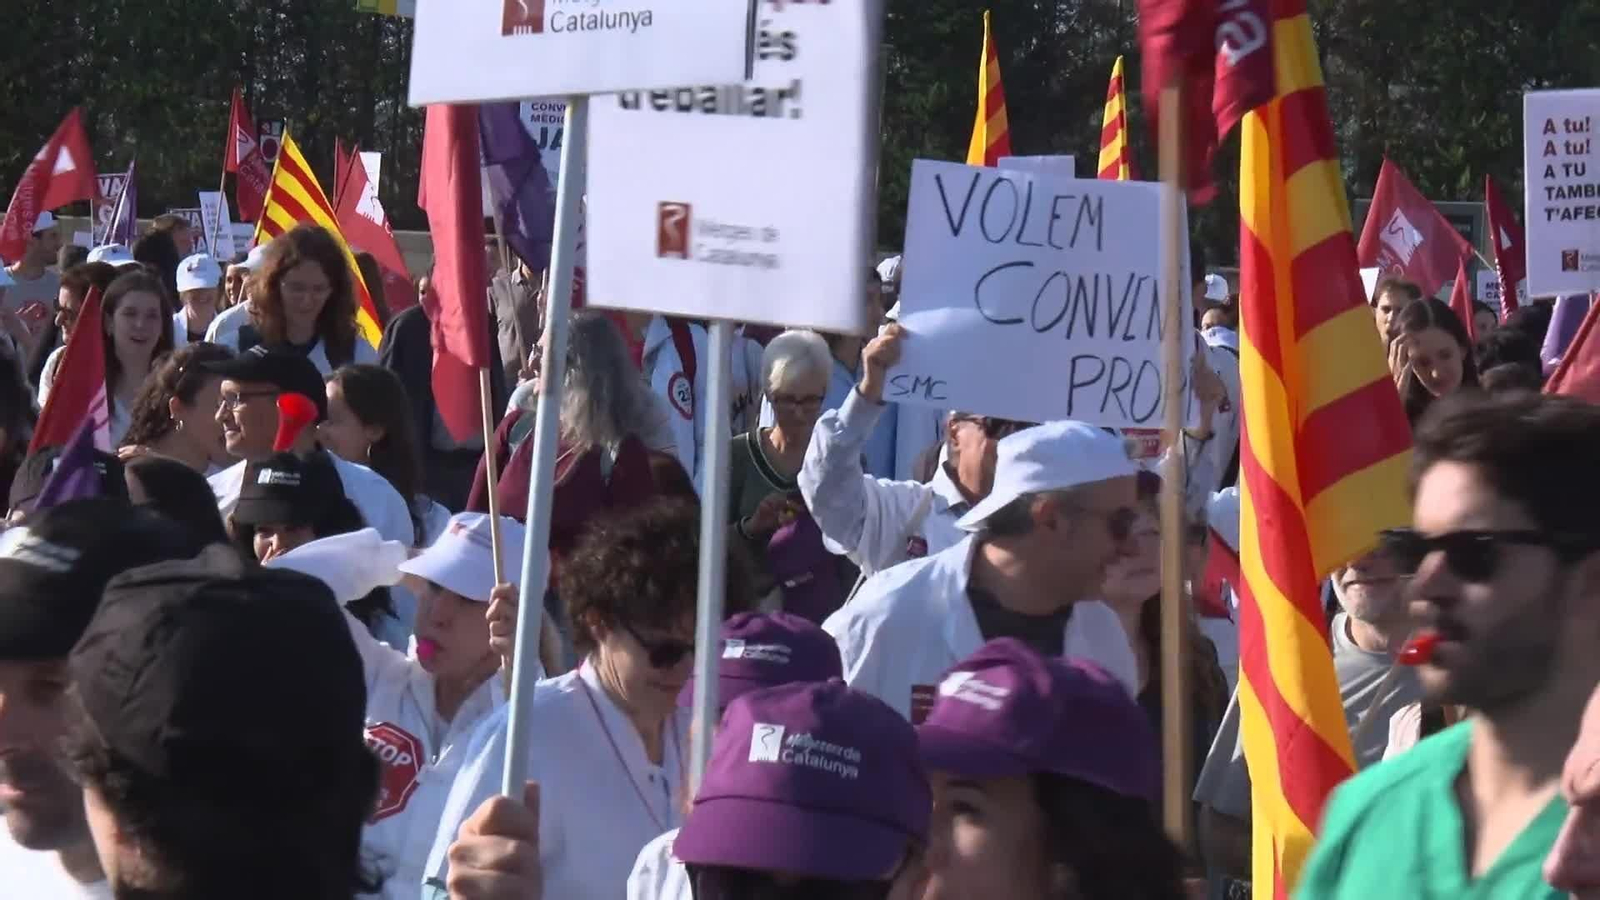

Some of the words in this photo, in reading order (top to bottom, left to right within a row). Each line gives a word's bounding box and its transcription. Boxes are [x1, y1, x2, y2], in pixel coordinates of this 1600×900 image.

[550, 9, 653, 34] Catalunya
[531, 102, 566, 111] CONV
[1543, 118, 1557, 135] A
[1563, 116, 1590, 133] tu!
[1543, 140, 1557, 157] A
[1564, 138, 1591, 155] tu!
[1544, 164, 1556, 179] A
[1562, 162, 1586, 177] TU
[934, 171, 1104, 252] VOLEM
[974, 260, 1182, 341] CONVEN
[889, 373, 948, 400] SMC
